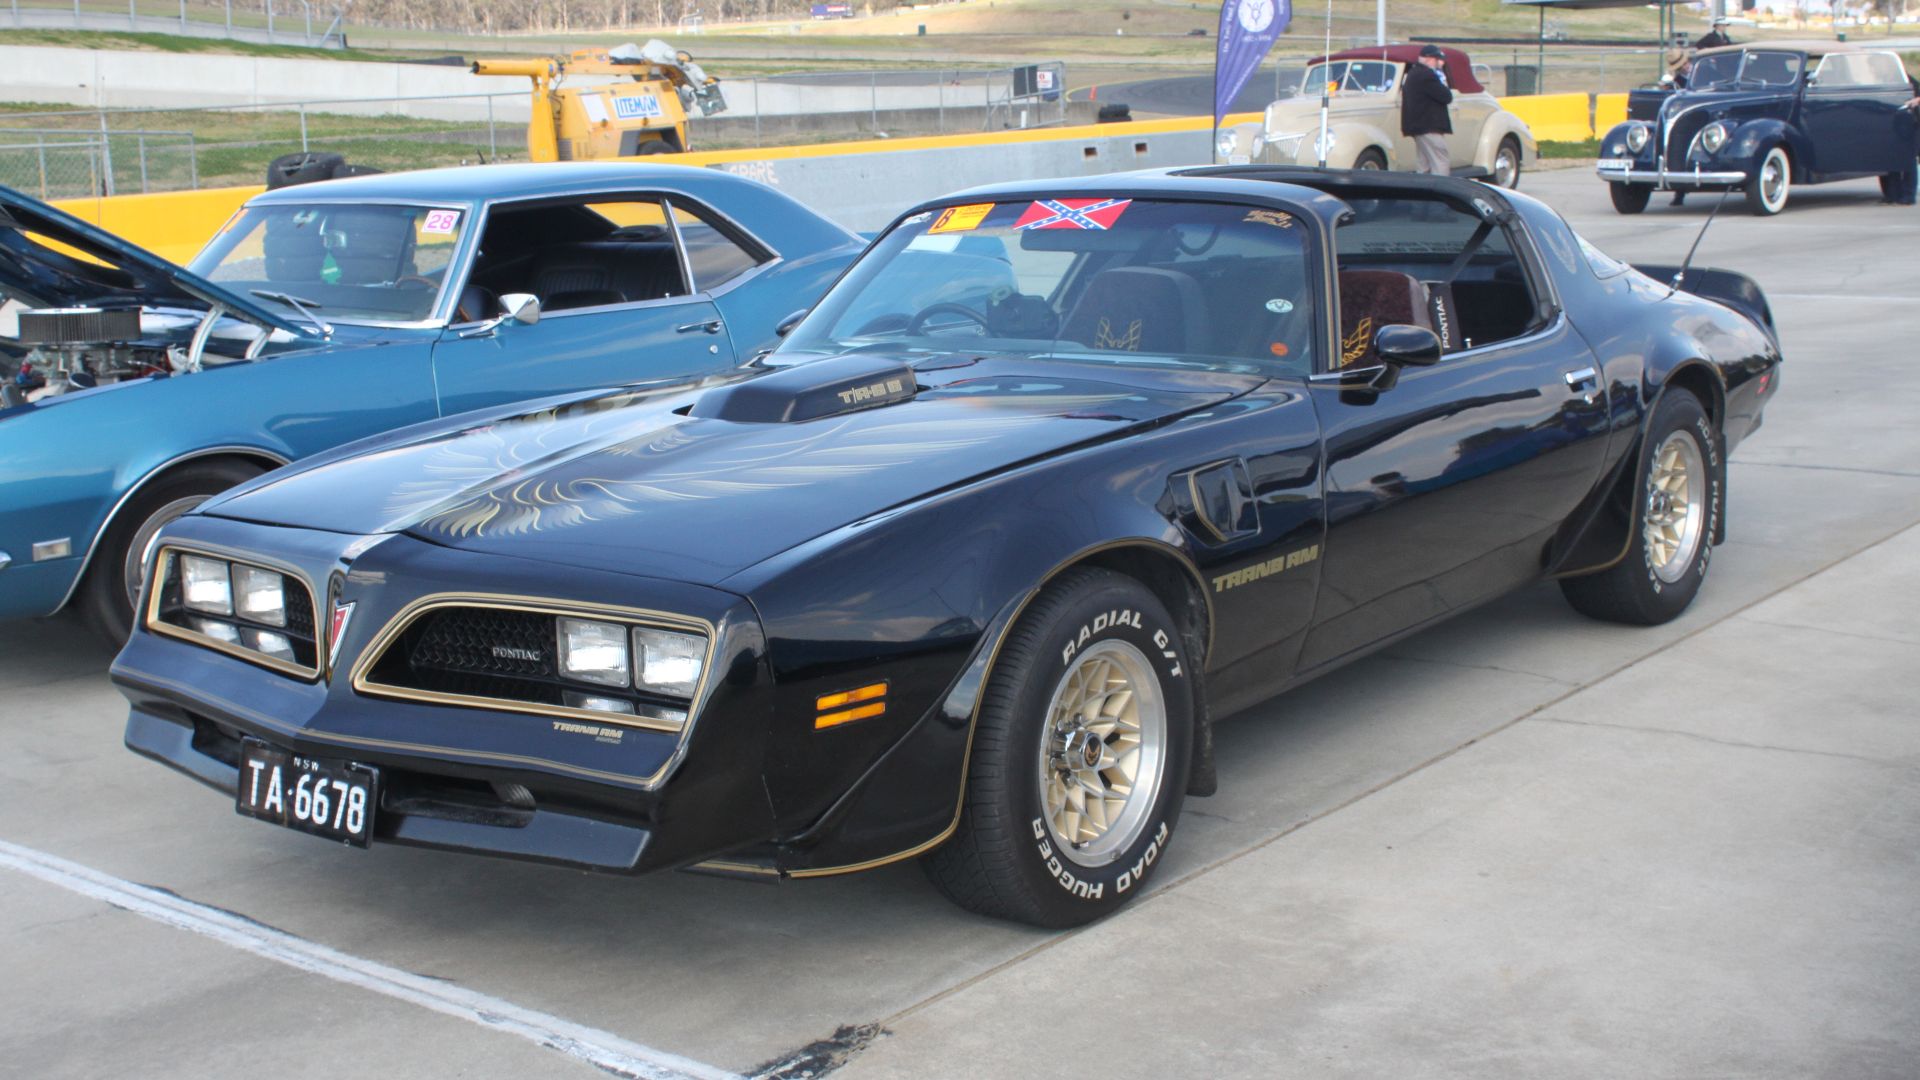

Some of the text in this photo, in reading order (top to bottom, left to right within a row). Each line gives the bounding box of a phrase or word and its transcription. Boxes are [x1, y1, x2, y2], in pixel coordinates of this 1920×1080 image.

[427, 214, 454, 230] 28
[933, 208, 957, 229] B
[1435, 295, 1451, 349] PONTIAC
[1212, 544, 1319, 593] TRANS AM
[492, 646, 541, 661] PONTIAC
[1062, 609, 1183, 677] RADIAL G/T
[294, 757, 320, 771] NSW
[1032, 817, 1169, 899] ROAD HUGGER
